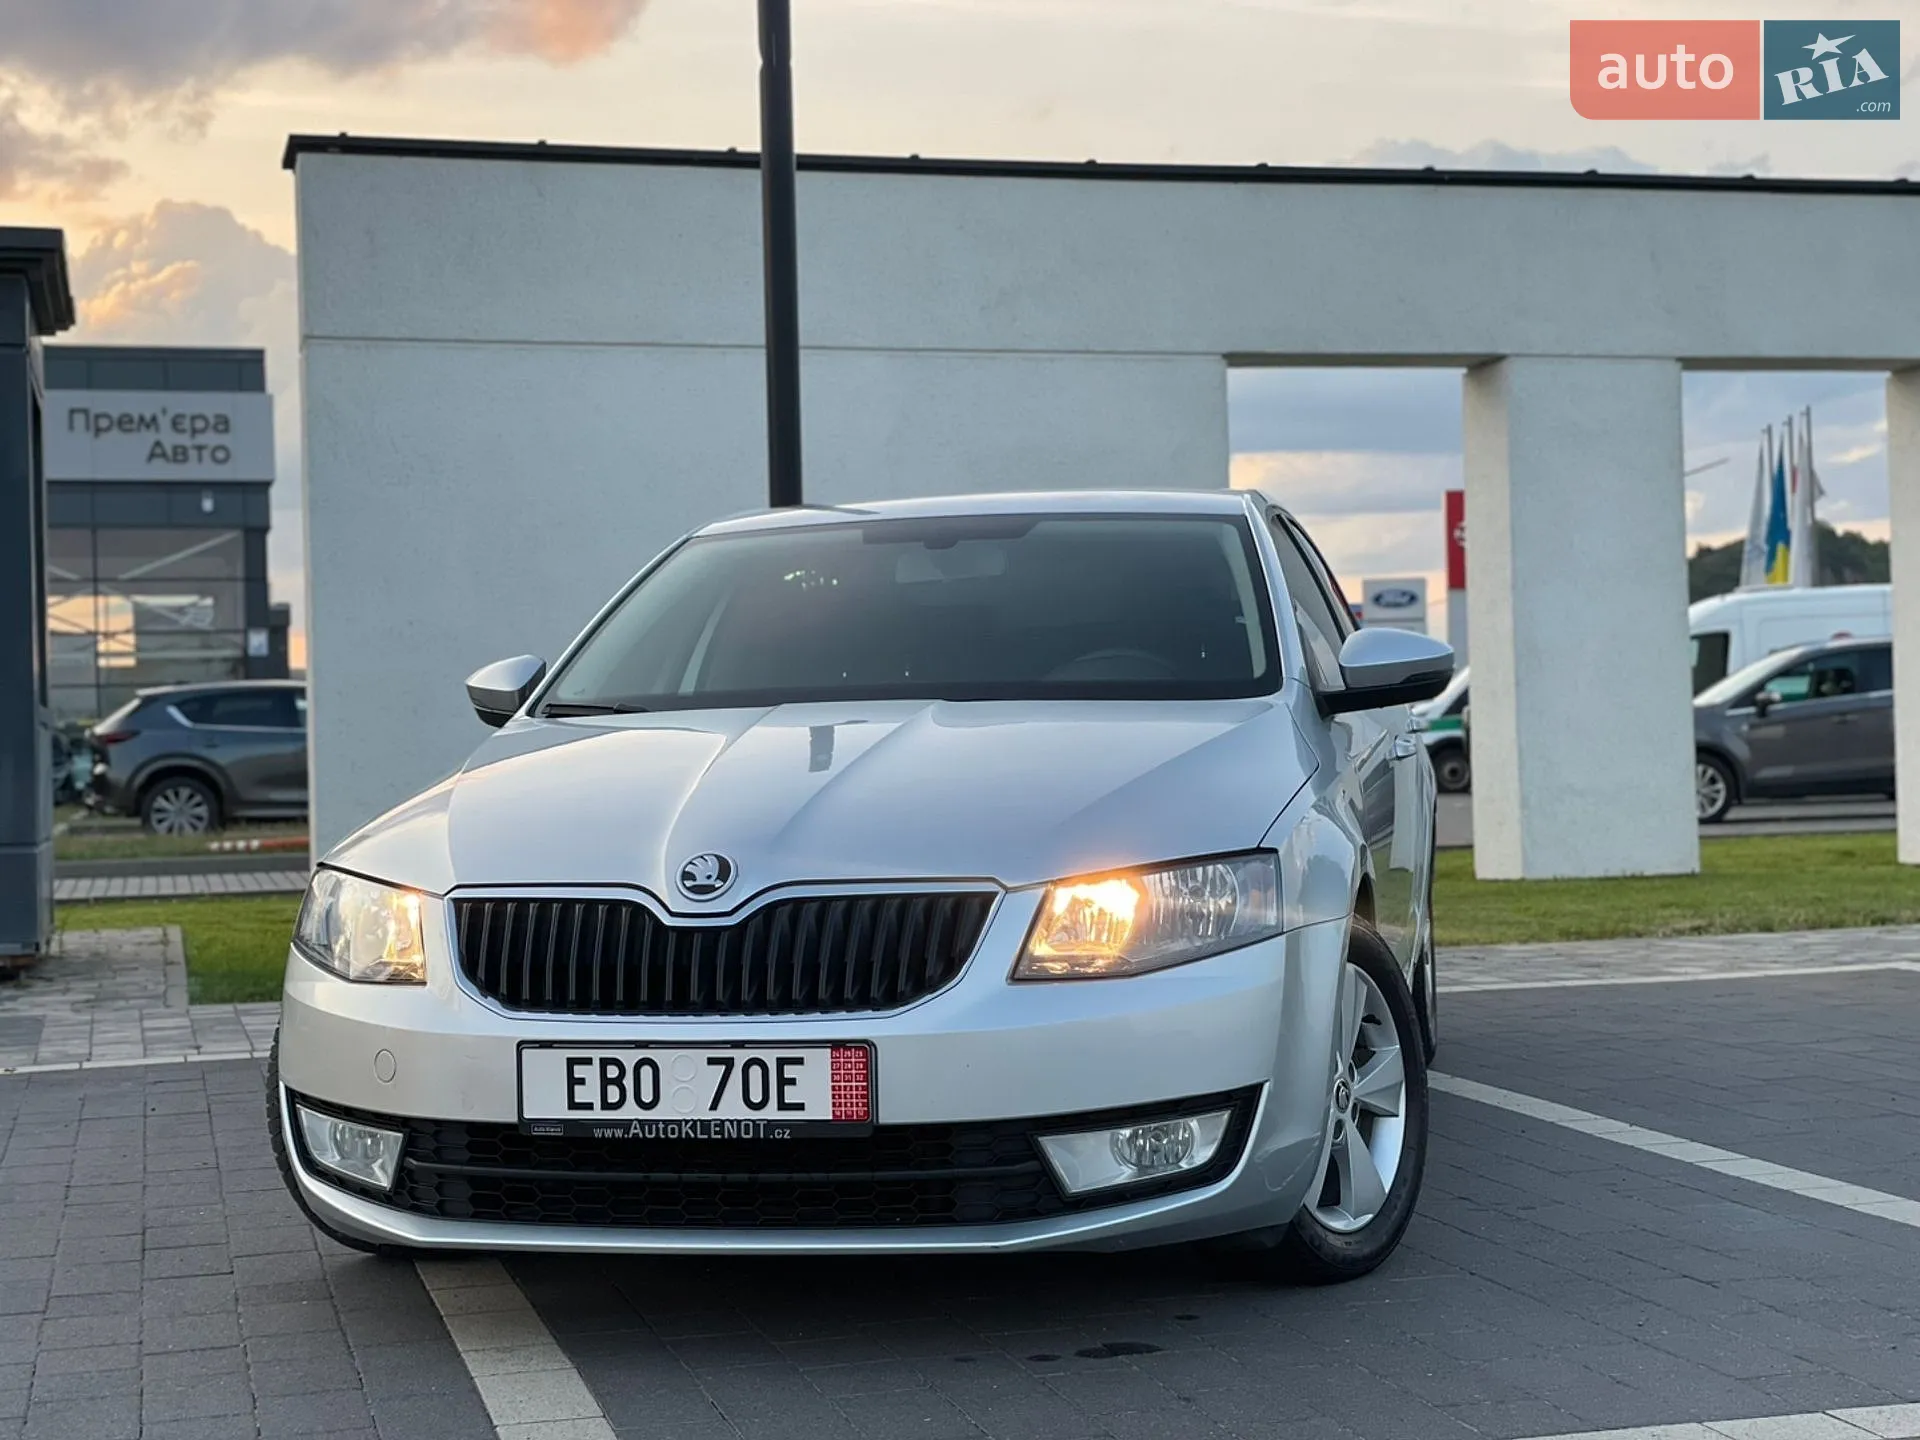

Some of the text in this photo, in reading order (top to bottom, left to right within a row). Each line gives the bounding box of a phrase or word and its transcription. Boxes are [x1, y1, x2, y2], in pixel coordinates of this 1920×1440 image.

[68, 406, 231, 439] Прем'єра
[146, 440, 231, 465] Авто
[593, 1120, 791, 1139] www.AutoKLENOT.cz
